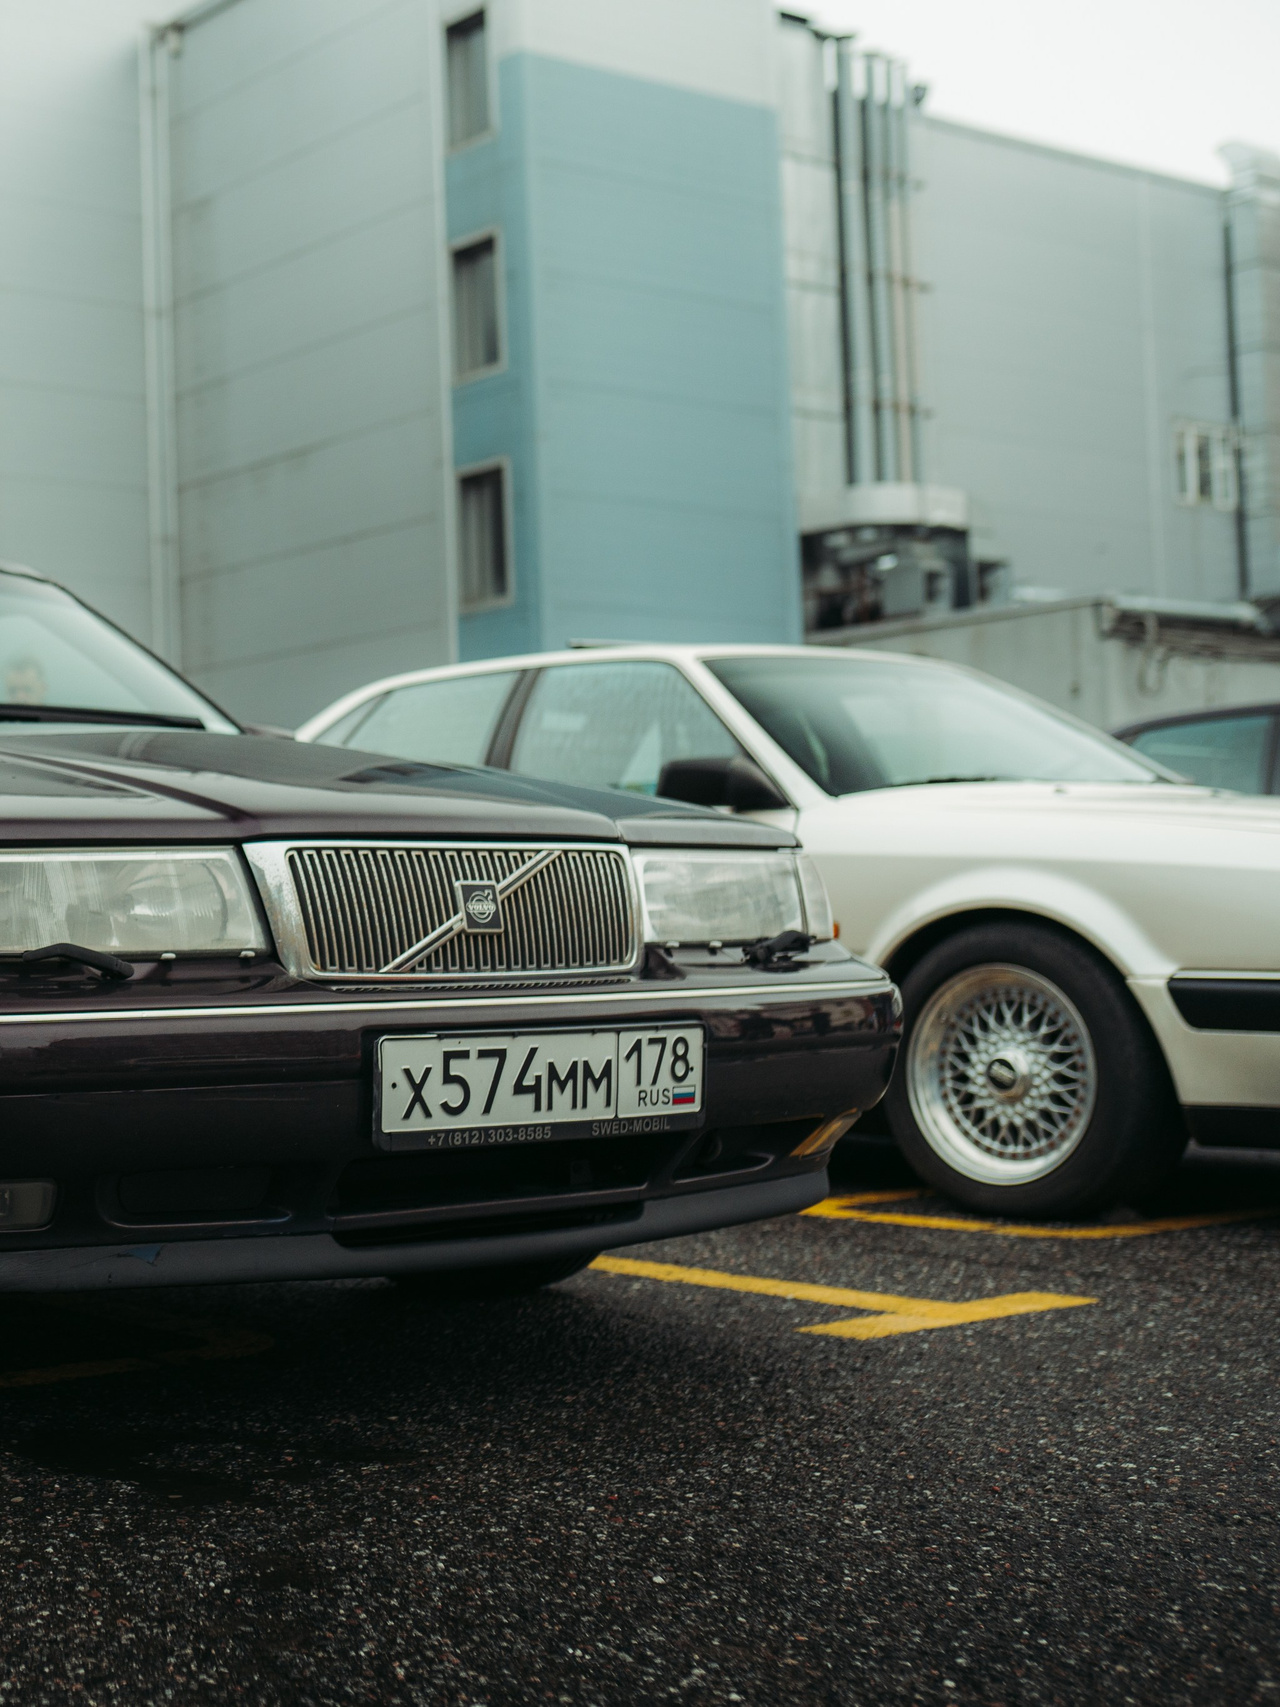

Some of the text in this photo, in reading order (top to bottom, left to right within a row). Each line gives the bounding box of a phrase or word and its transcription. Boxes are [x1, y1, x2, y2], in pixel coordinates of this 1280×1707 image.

[624, 1036, 689, 1088] 178
[638, 1088, 671, 1107] RUS
[428, 1126, 552, 1147] +7 (812) 303-8585
[591, 1117, 671, 1137] SWED-MOBIL
